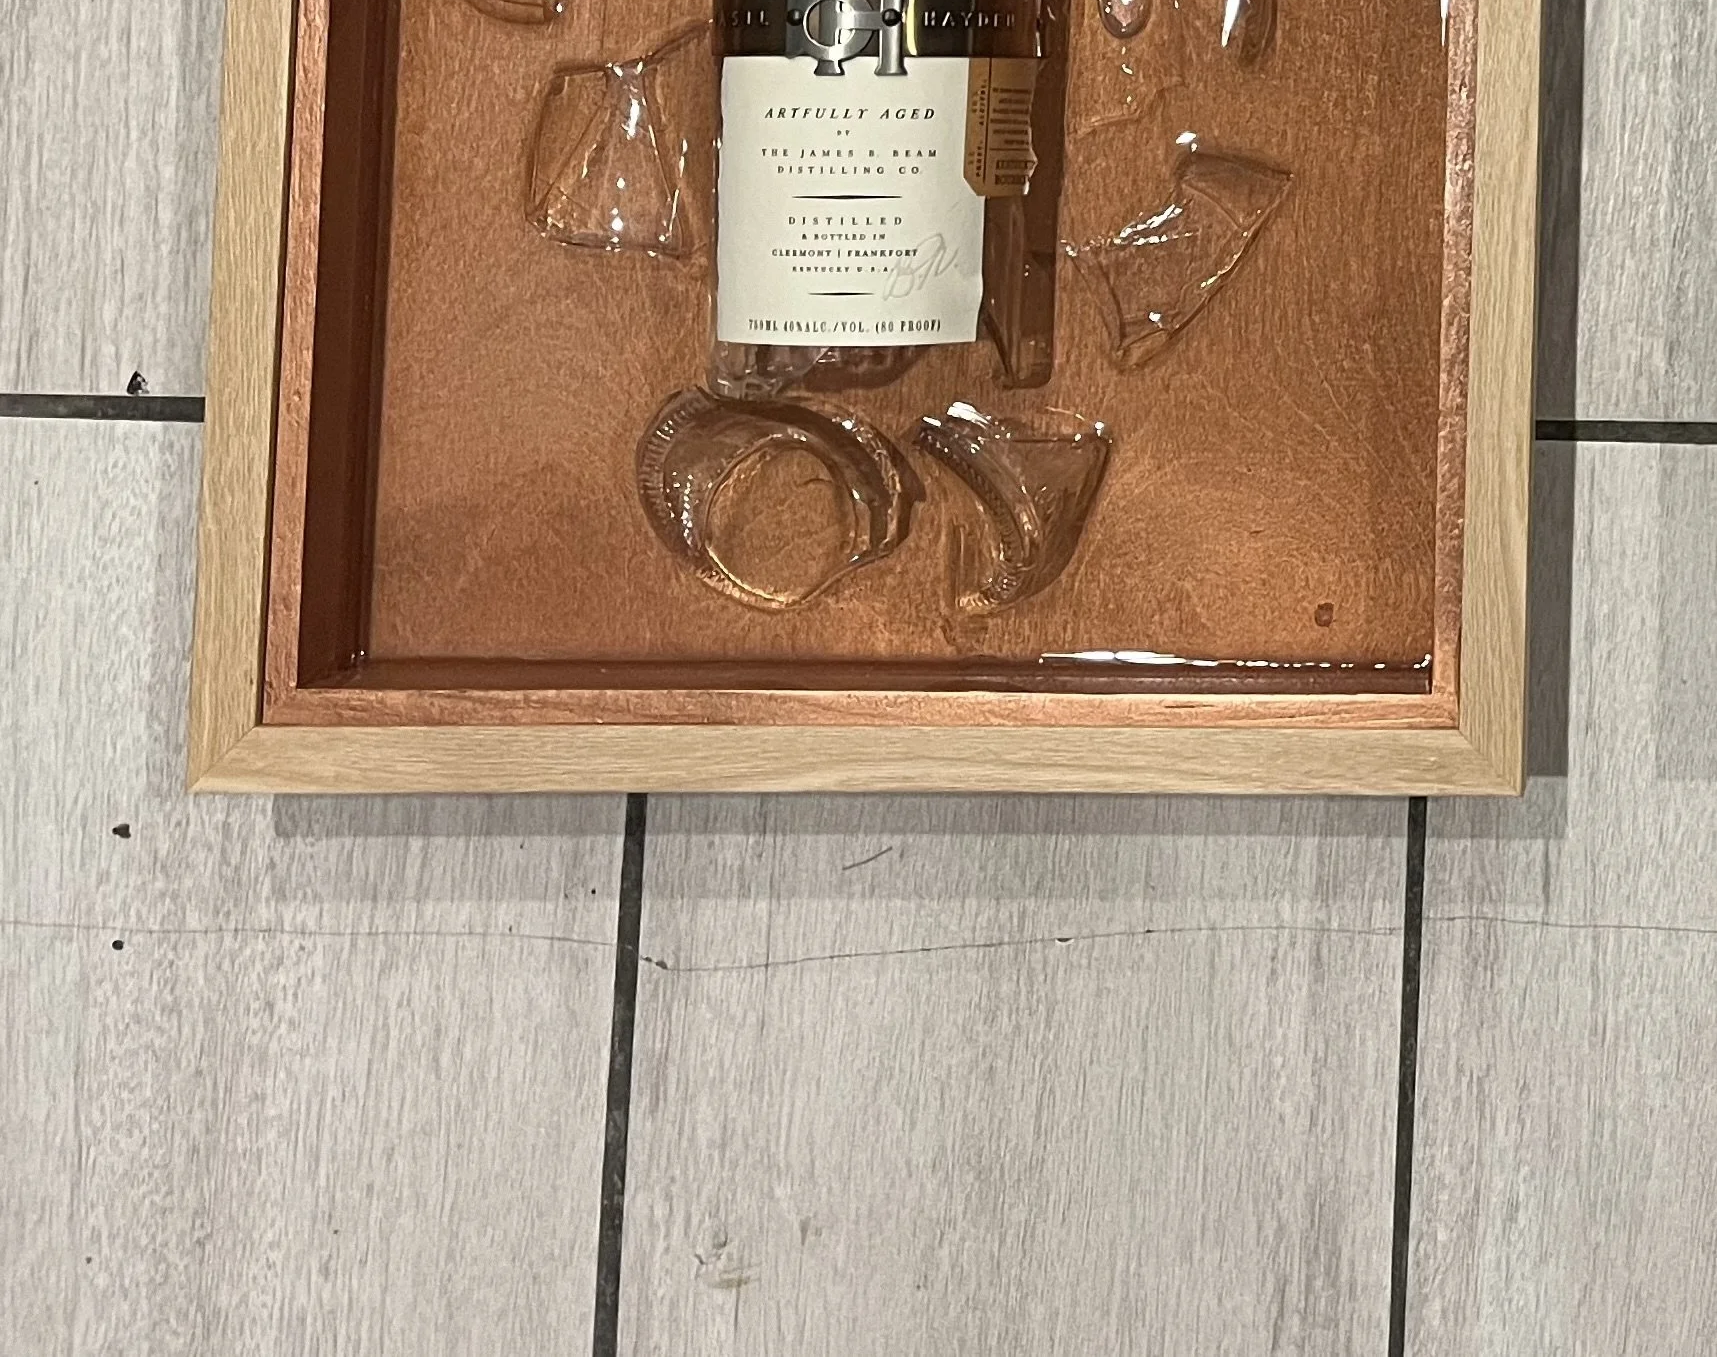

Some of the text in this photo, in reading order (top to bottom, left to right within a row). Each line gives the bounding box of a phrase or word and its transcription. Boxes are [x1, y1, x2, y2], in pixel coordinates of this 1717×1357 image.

[764, 107, 936, 120] ARTFULLY AGED
[761, 148, 789, 158] THE
[800, 149, 854, 159] JAMES
[892, 149, 938, 158] BEAM
[777, 166, 885, 175] DISTILLING
[788, 216, 903, 226] DISTILLED
[813, 233, 867, 241] BOTTLED
[872, 233, 887, 241] IN
[771, 248, 919, 258] CLERMONT FRANKFORT
[791, 266, 851, 274] KENTUCKY
[874, 320, 895, 335] (80
[899, 318, 942, 333] PROOF)
